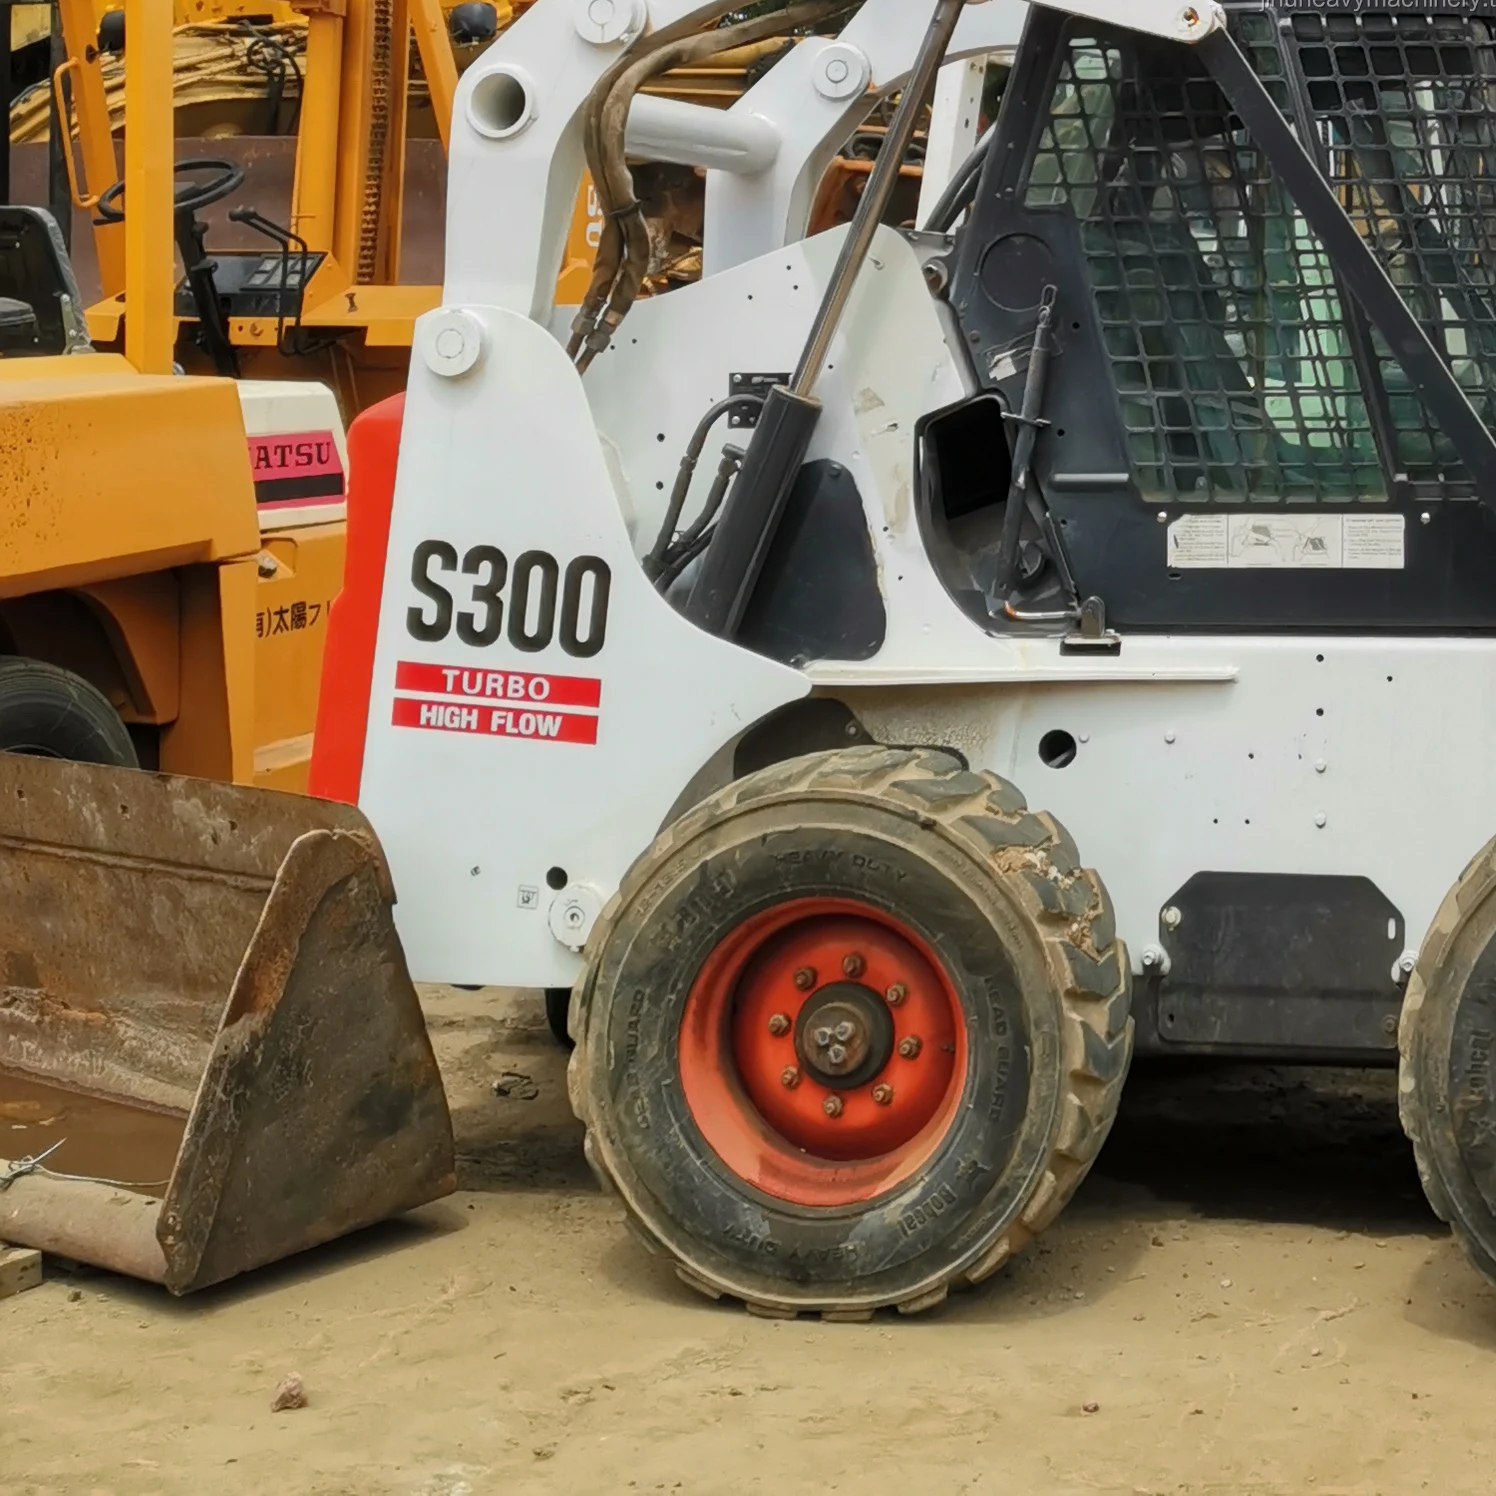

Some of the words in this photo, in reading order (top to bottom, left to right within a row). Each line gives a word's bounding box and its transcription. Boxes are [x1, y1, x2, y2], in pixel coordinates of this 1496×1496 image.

[249, 441, 331, 470] ATSU
[406, 538, 612, 659] S300
[441, 669, 550, 701] TURBO
[419, 703, 478, 731] HIGH
[490, 711, 563, 737] FLOW
